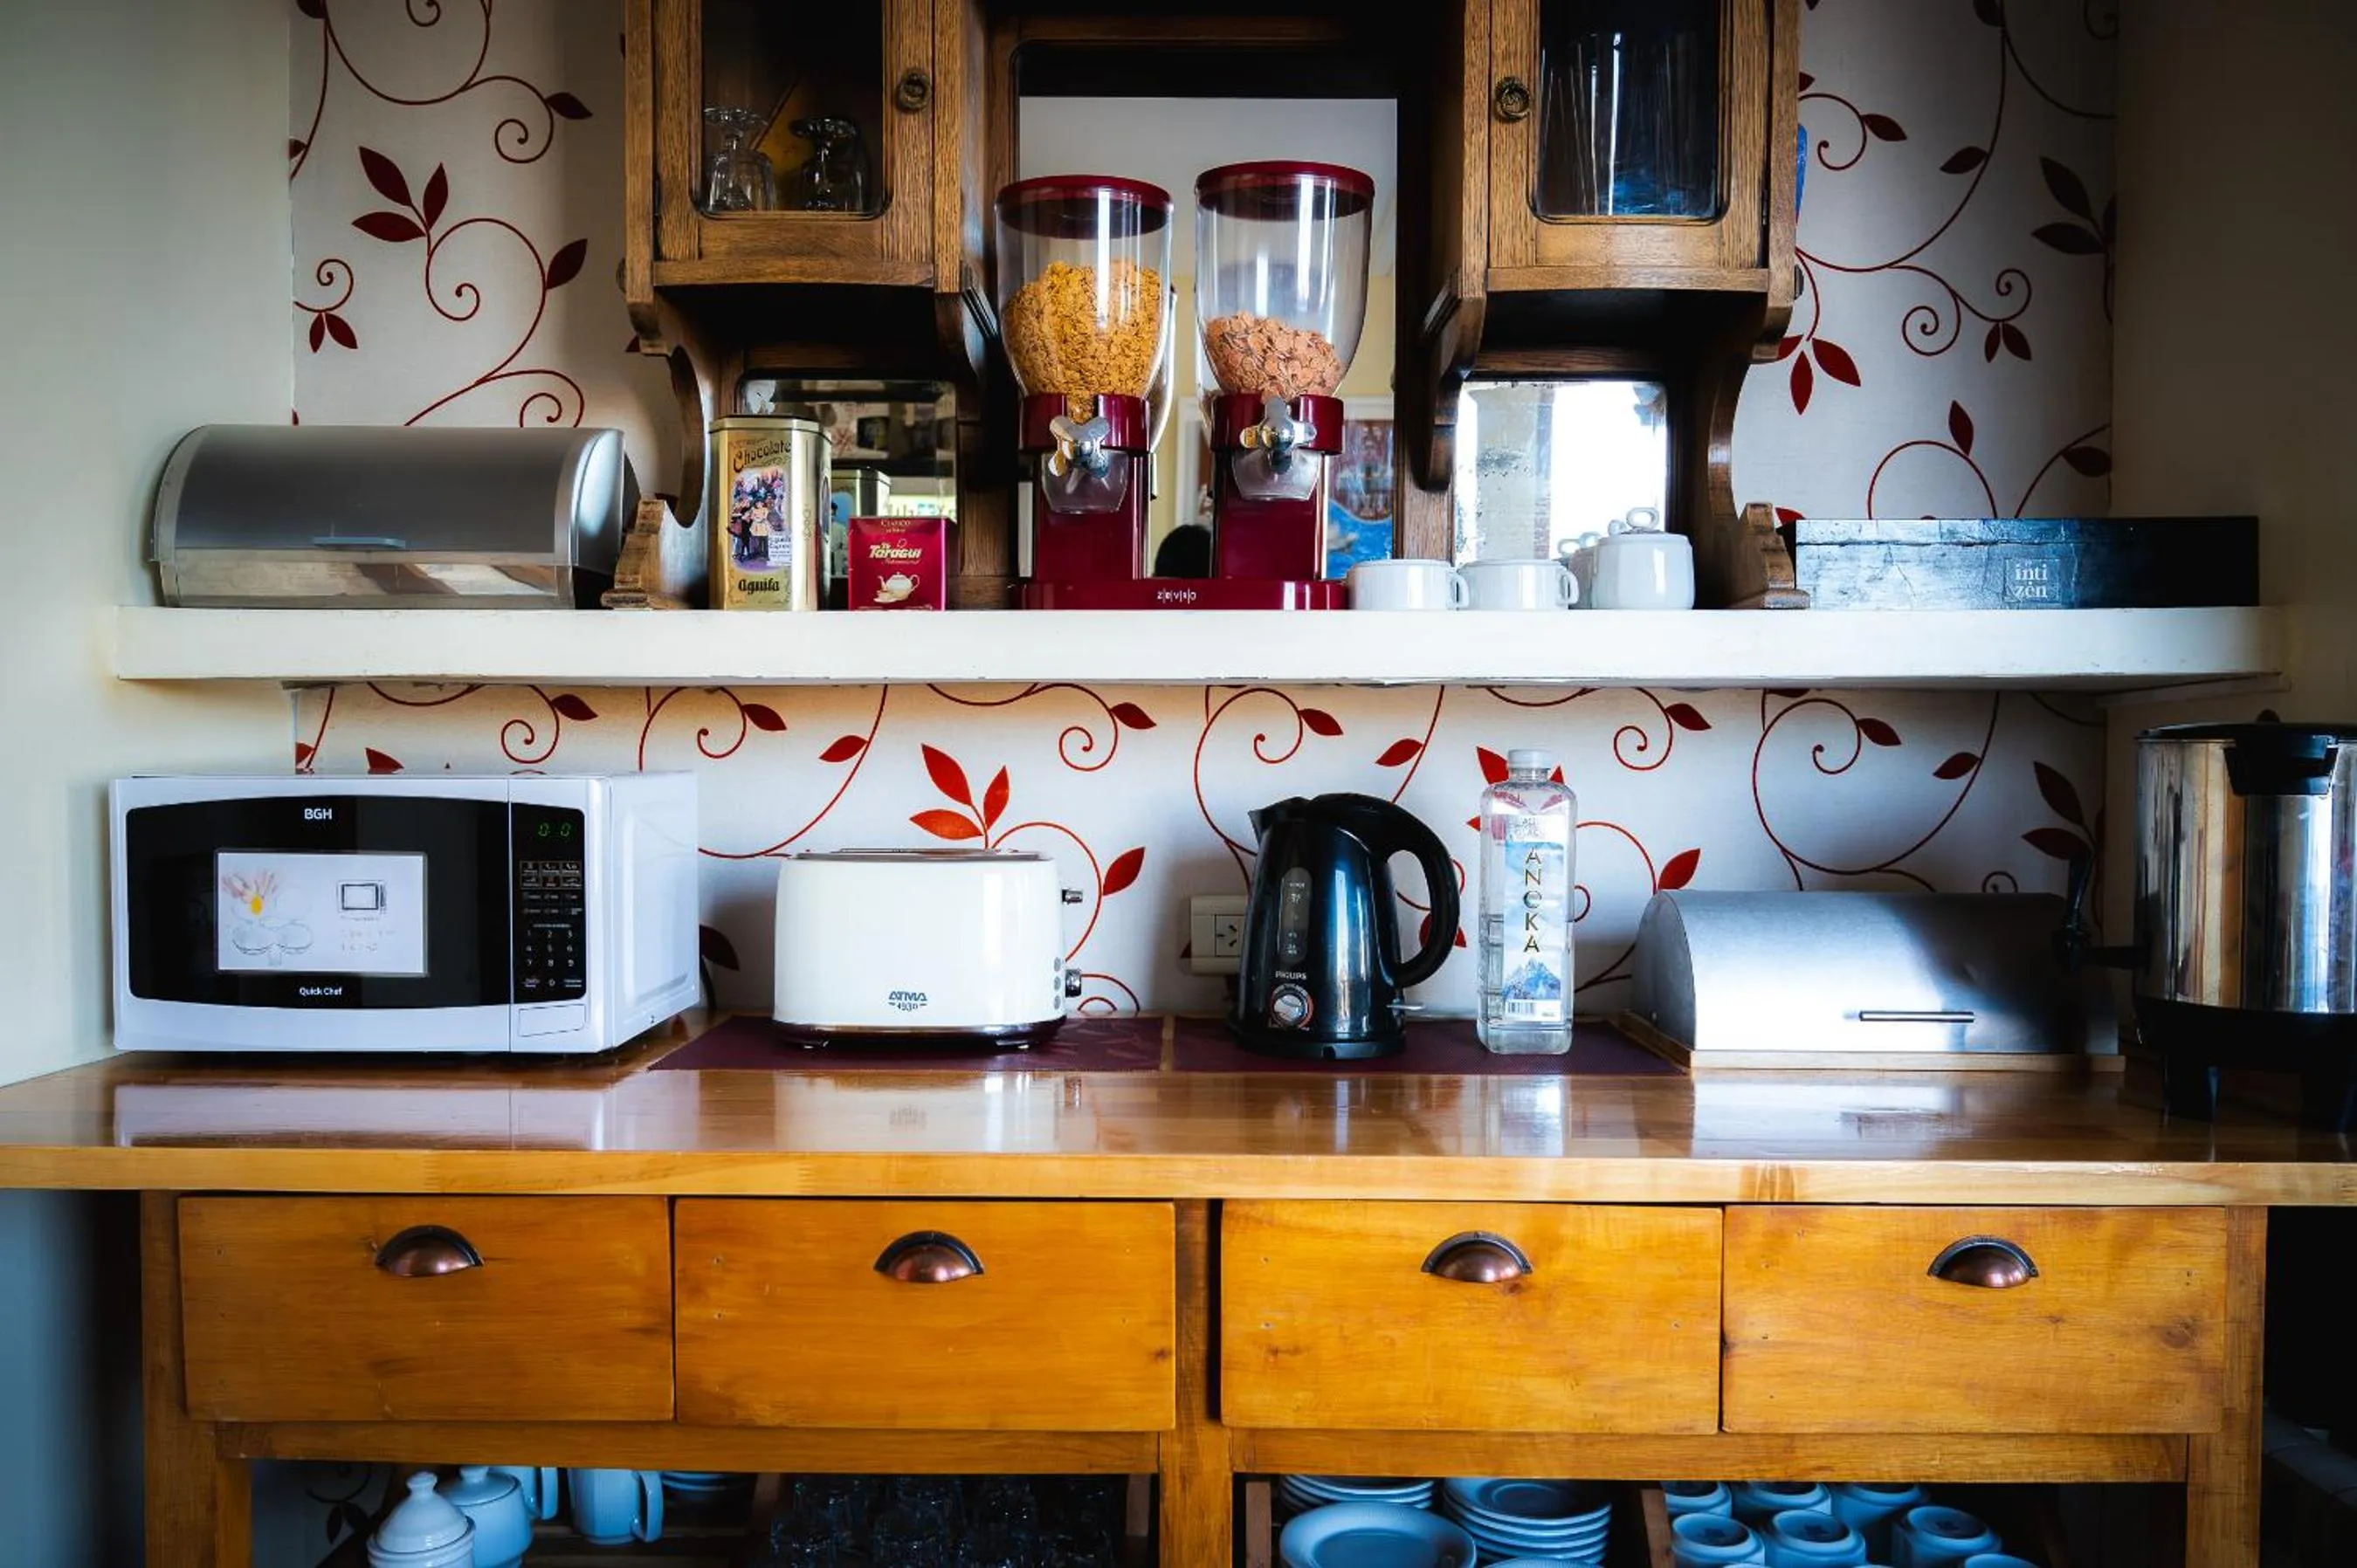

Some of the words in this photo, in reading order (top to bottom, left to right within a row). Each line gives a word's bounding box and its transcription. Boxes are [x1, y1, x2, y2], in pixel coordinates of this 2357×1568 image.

[2015, 563, 2048, 581] inti
[304, 808, 333, 820] BGH
[299, 986, 323, 997] Quick
[323, 986, 342, 996] Chef
[888, 990, 928, 1002] ATMA
